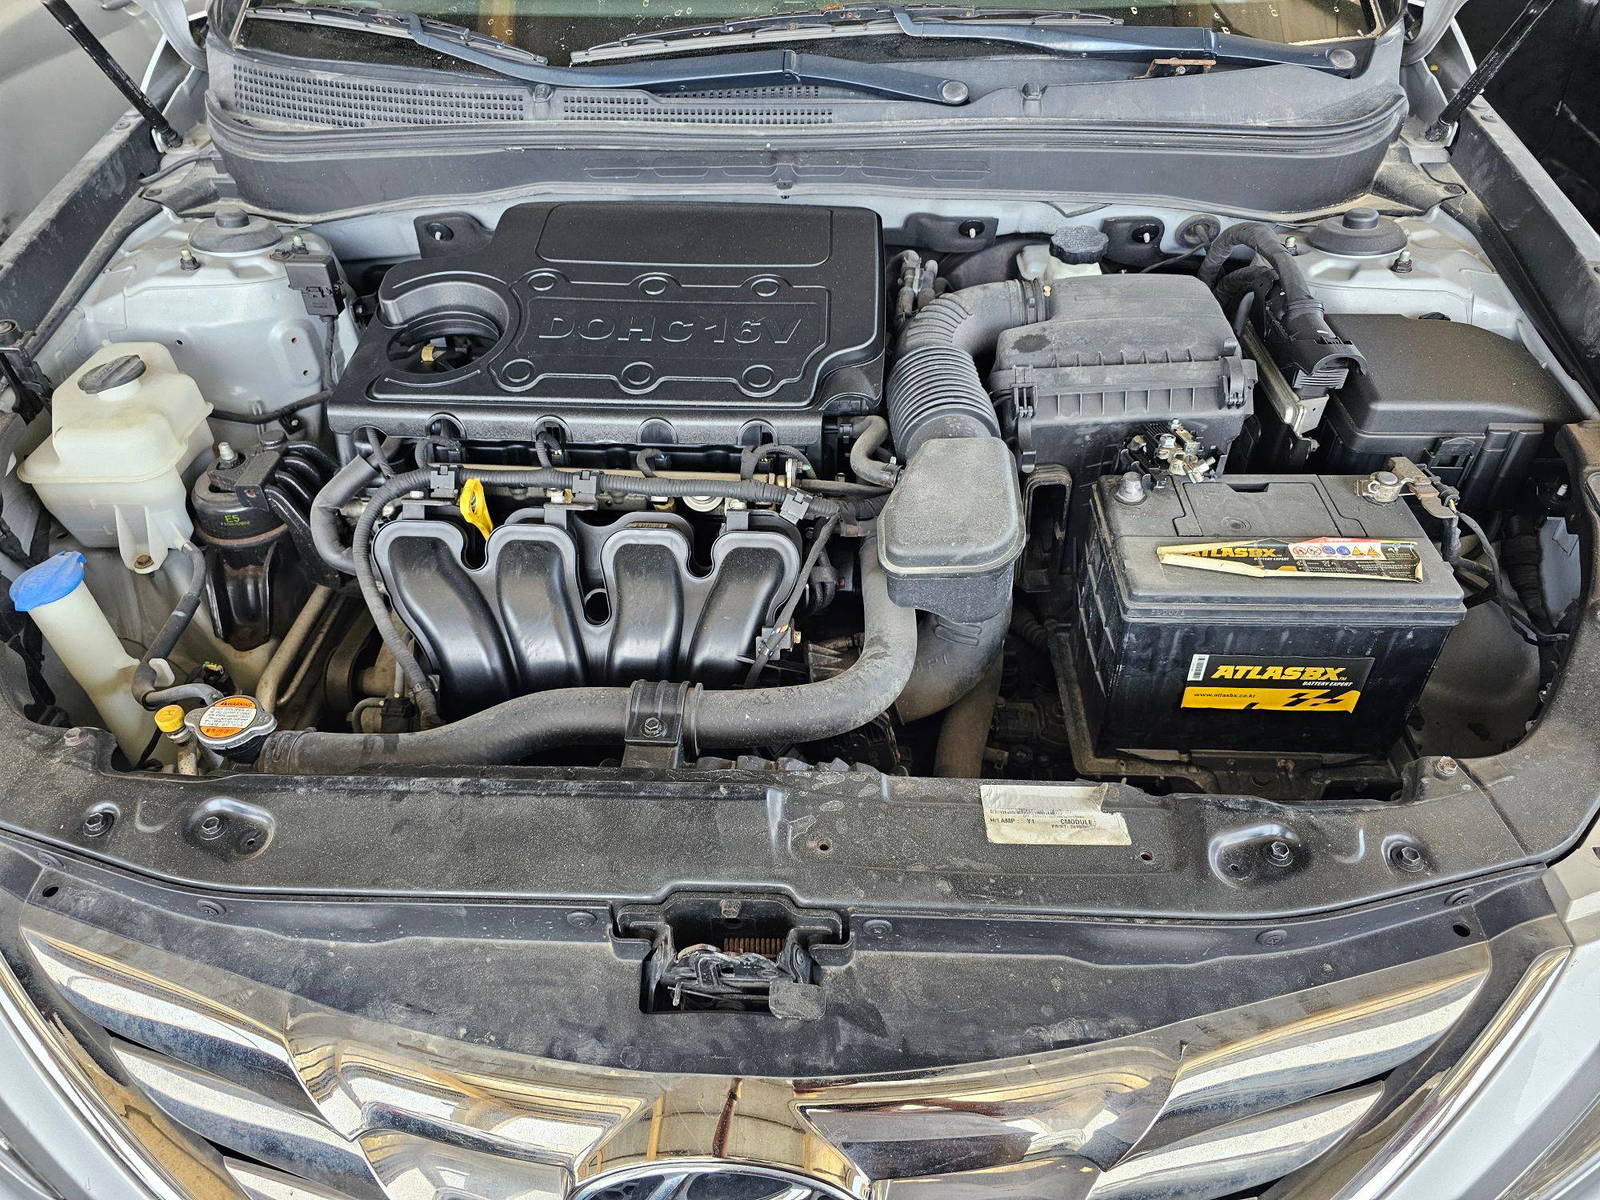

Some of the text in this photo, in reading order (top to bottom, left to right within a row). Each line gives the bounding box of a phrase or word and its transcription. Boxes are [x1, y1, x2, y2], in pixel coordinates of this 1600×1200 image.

[538, 316, 802, 344] DOHC 16V
[1211, 665, 1346, 681] ATLASBX
